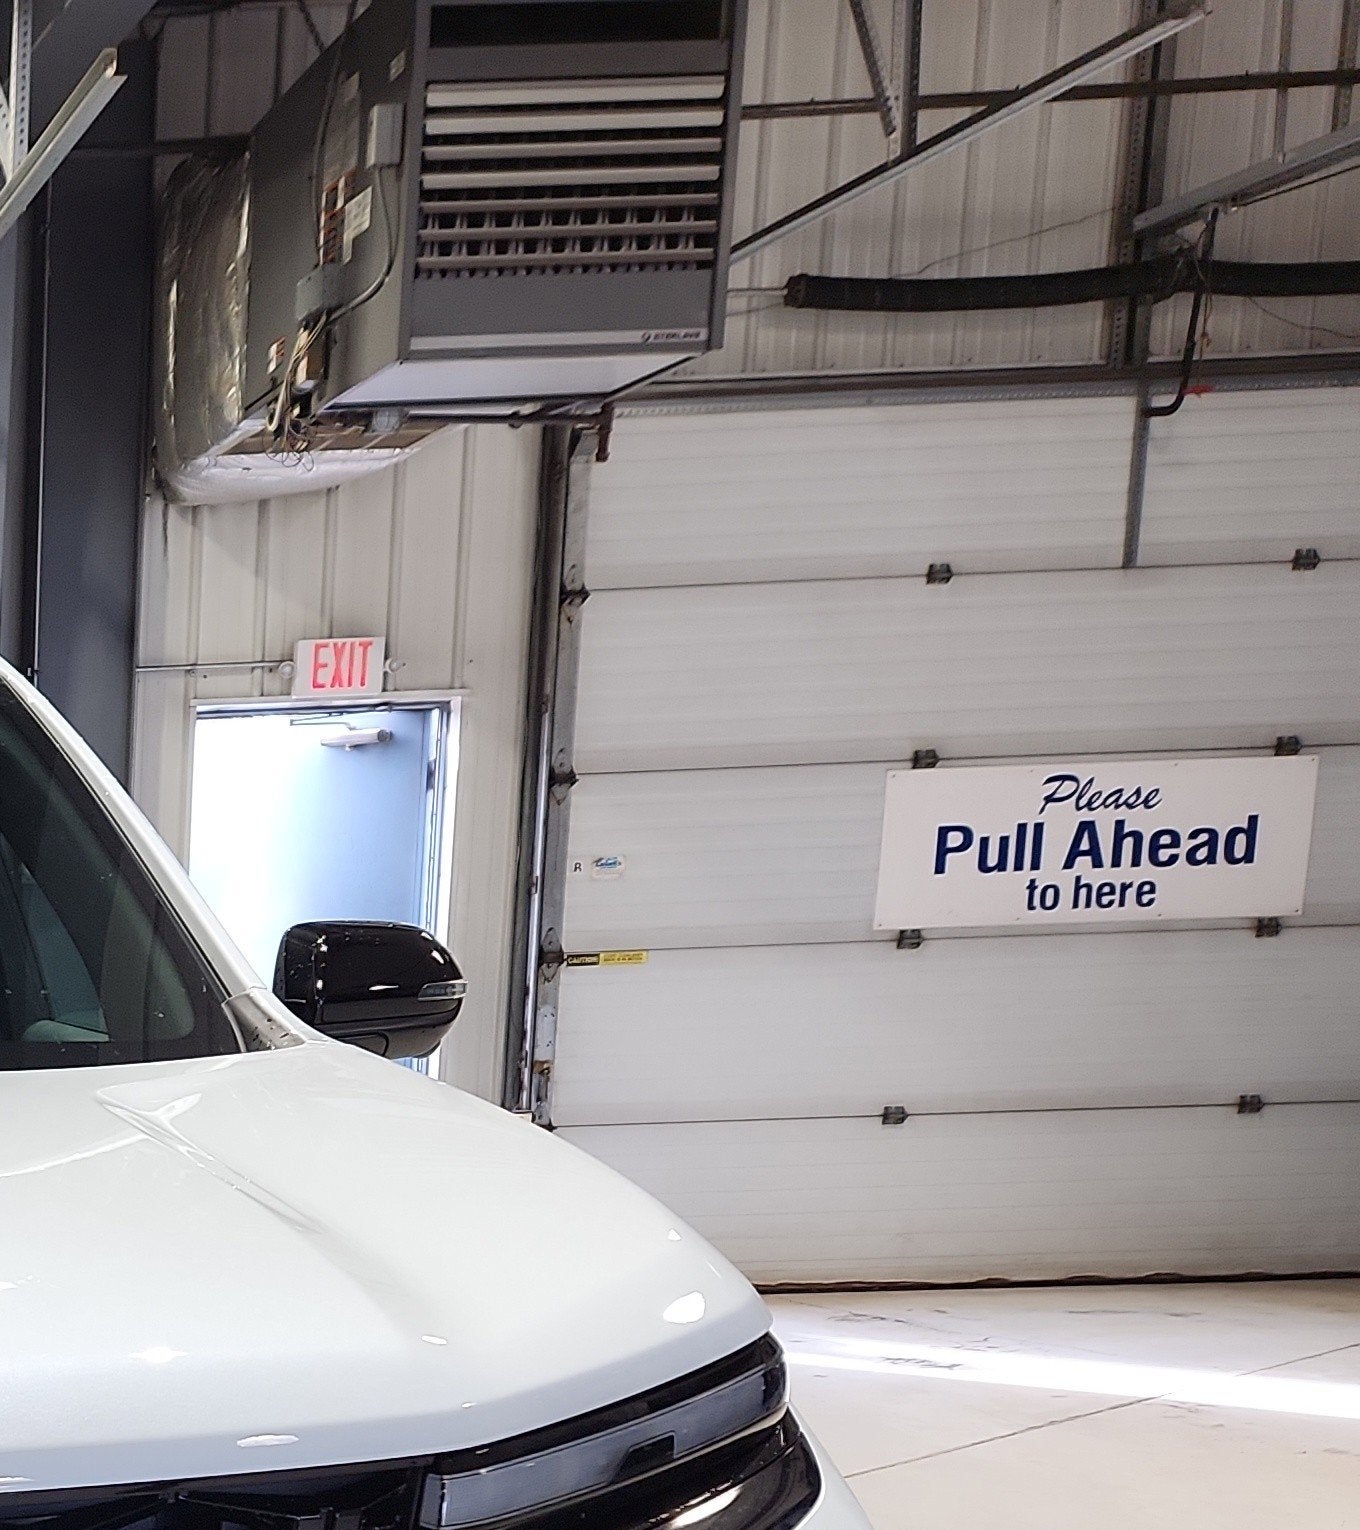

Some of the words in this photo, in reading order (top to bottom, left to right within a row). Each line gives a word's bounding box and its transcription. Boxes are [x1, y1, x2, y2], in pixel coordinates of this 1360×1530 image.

[312, 641, 374, 688] EXIT
[1039, 774, 1162, 814] Please
[934, 822, 1045, 874] Pull
[1061, 814, 1259, 871] Ahead
[574, 862, 583, 872] R
[1026, 878, 1060, 911] to
[1071, 875, 1157, 909] here
